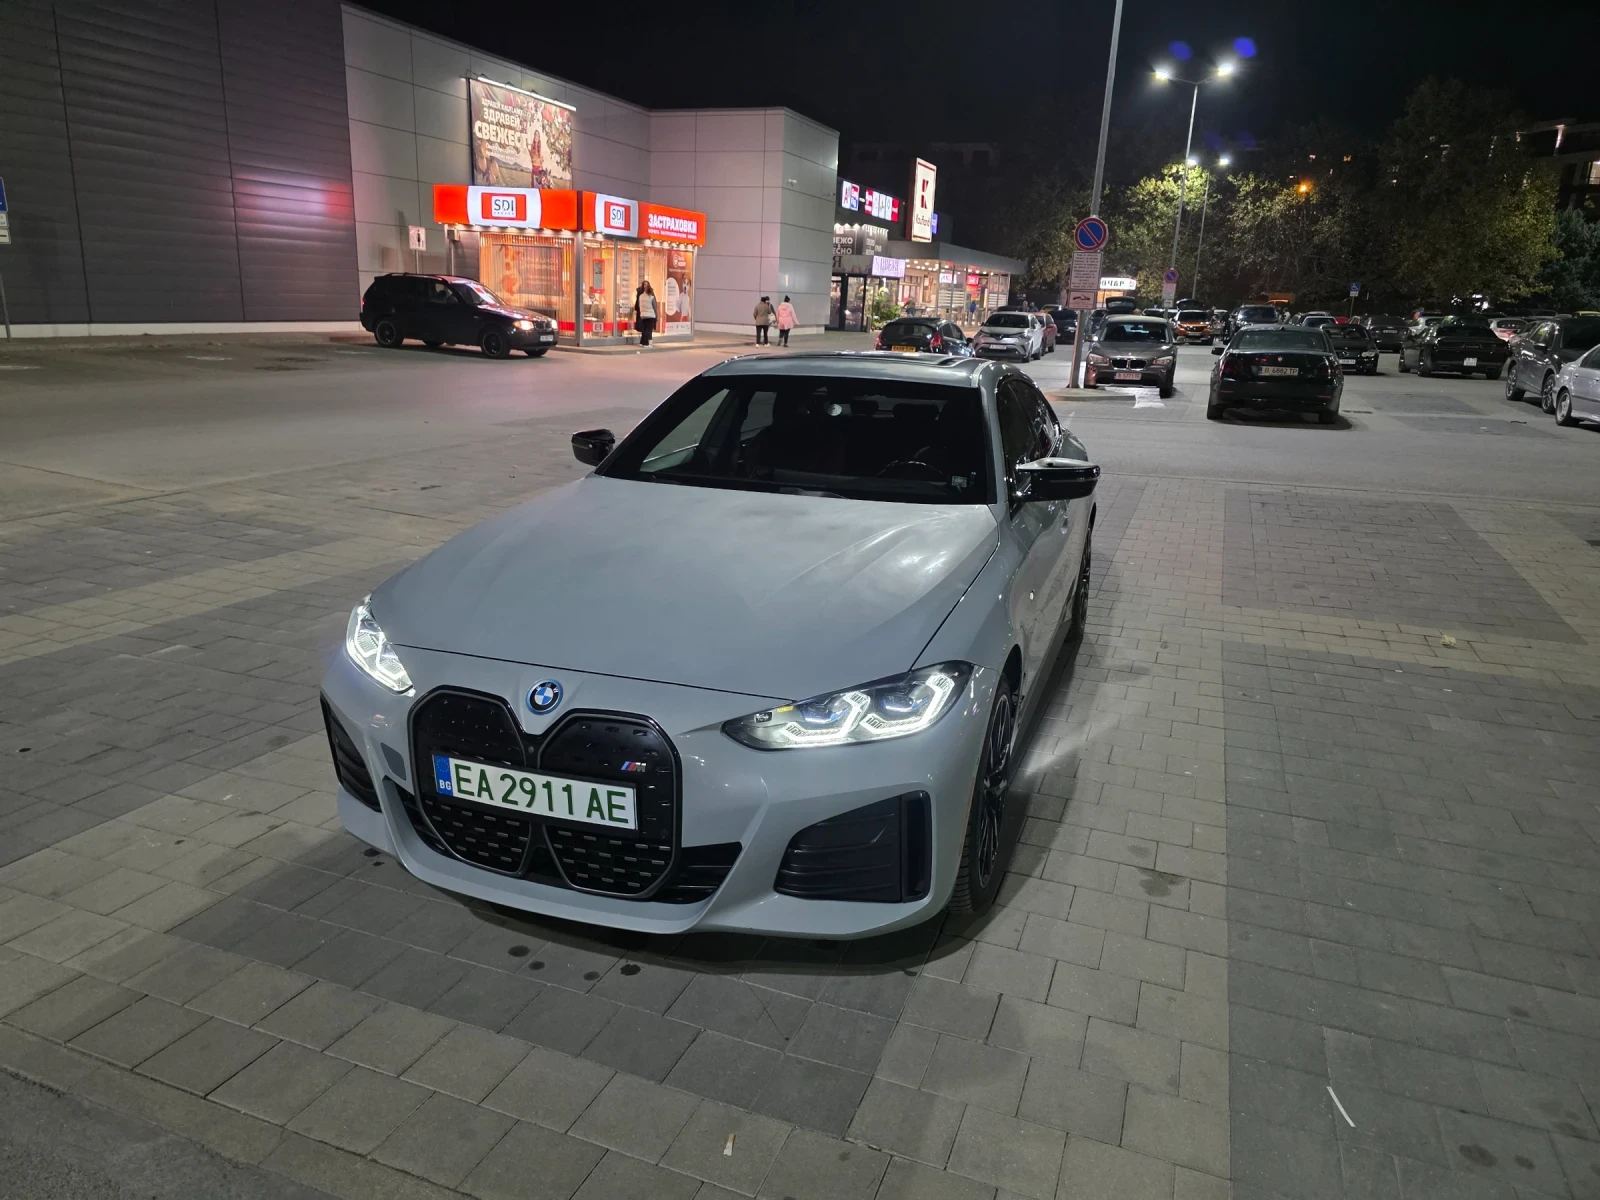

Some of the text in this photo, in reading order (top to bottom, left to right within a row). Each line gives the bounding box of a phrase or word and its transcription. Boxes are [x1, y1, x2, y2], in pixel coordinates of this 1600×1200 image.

[494, 199, 514, 211] SDI
[612, 208, 624, 221] SDI
[648, 213, 698, 234] ЗАСТРАХОВКИ
[439, 779, 451, 791] BG
[454, 763, 629, 824] EA 2911 AE
